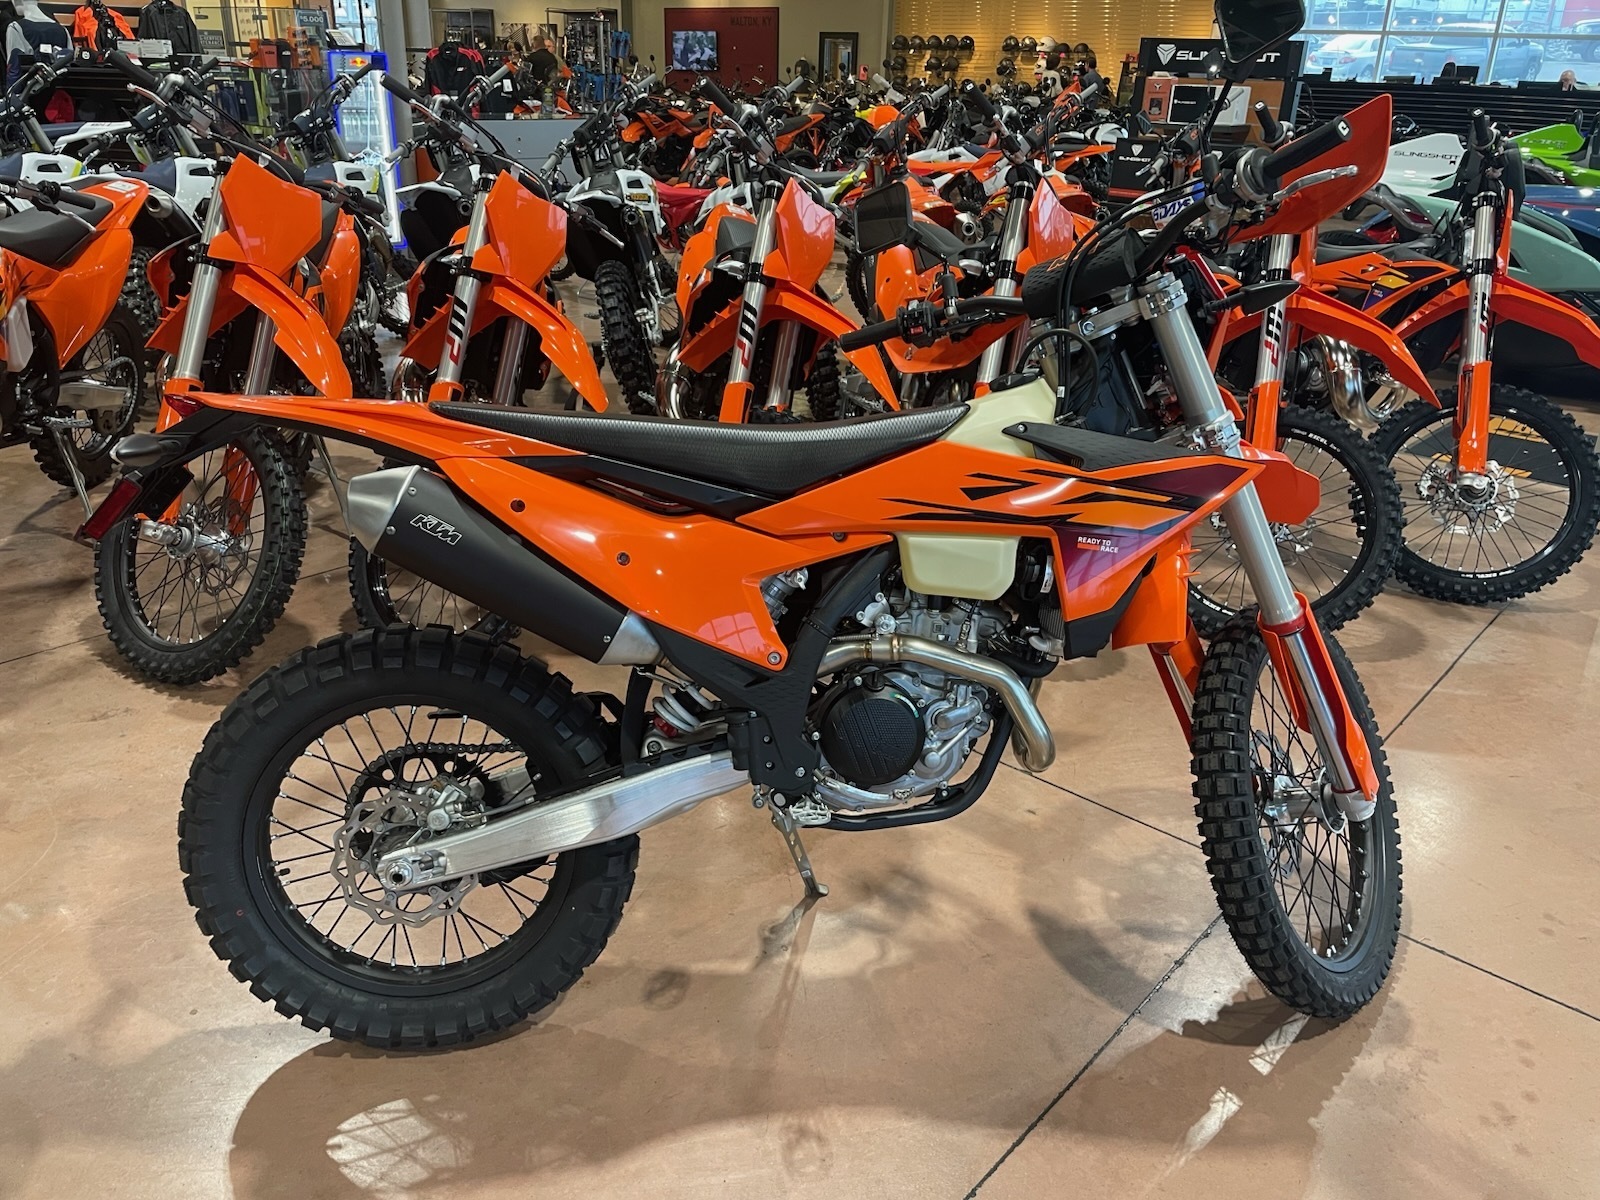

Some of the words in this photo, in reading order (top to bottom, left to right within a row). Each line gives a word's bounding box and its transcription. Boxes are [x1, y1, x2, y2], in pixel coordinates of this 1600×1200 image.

[1394, 151, 1460, 160] SLINGSHOT
[409, 513, 462, 545] KTM
[1077, 536, 1101, 545] READY
[1100, 545, 1119, 553] RACE
